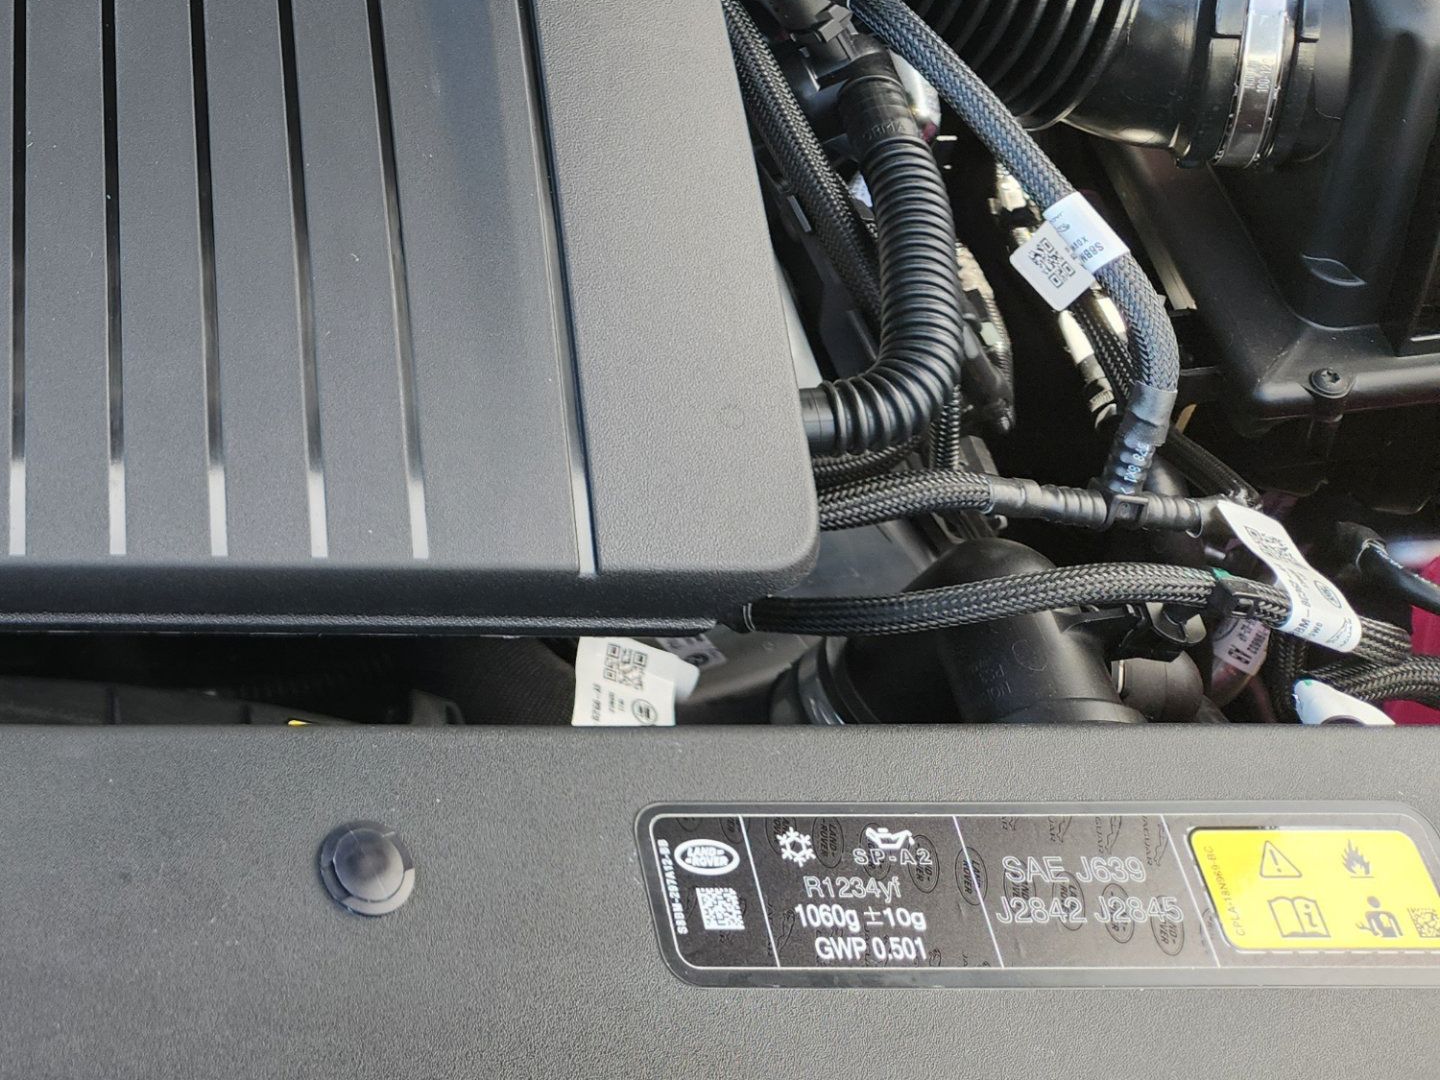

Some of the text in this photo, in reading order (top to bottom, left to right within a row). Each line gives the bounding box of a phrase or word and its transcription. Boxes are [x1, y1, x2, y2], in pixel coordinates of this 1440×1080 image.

[852, 848, 933, 866] SP-A2
[1002, 856, 1147, 882] SAE J639
[803, 875, 902, 904] R1234yf
[794, 903, 927, 933] 1060g ±10g
[996, 896, 1088, 923] J2842
[1094, 896, 1184, 923] J2845
[815, 936, 927, 960] GWP 0.501
